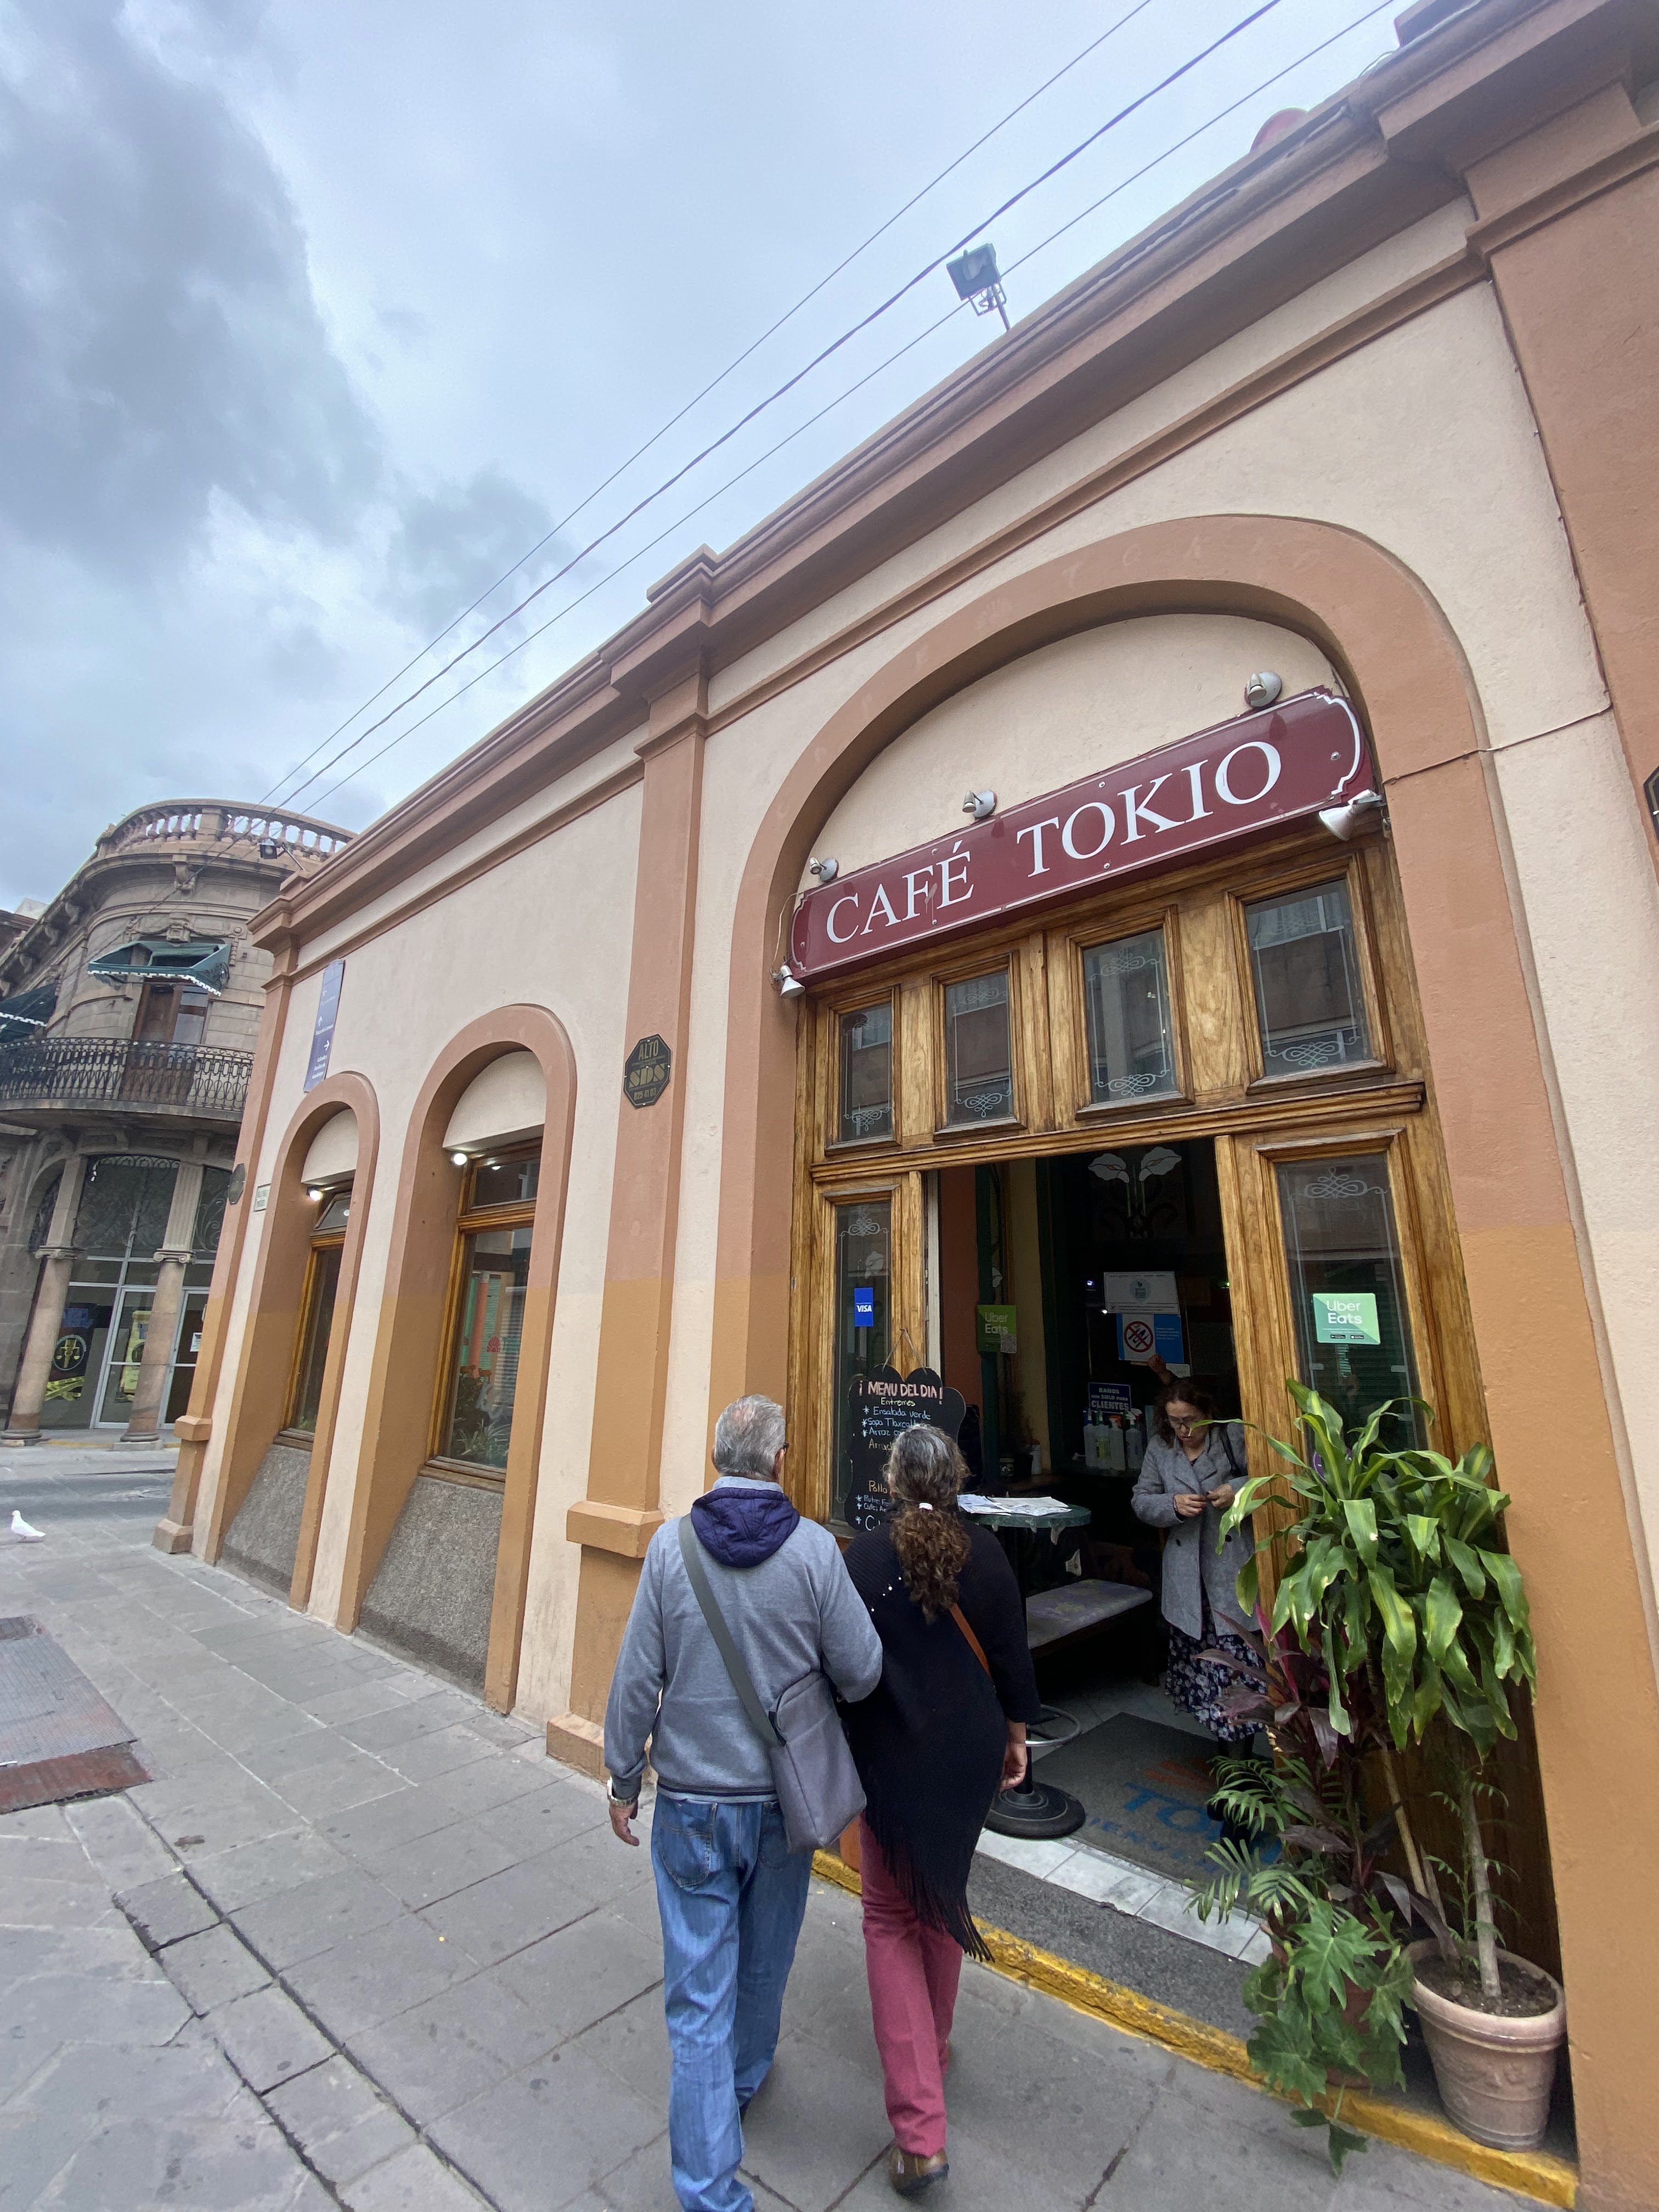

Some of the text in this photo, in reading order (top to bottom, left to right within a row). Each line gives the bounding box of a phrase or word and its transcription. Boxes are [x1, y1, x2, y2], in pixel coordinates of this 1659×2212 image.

[826, 741, 1282, 943] CAFÉ TOKIO
[638, 1040, 659, 1061] ALTO
[1327, 1300, 1361, 1311] Uber
[985, 1311, 1008, 1323] Uber
[1328, 1312, 1363, 1324] Eats
[985, 1323, 1008, 1335] Eats
[868, 1381, 898, 1397] MENU
[900, 1383, 919, 1397] DEL
[873, 1406, 932, 1420] Ensalada verde
[867, 1418, 883, 1427] Sopa
[869, 1427, 891, 1436] Arroz
[868, 1480, 888, 1494] Pollo
